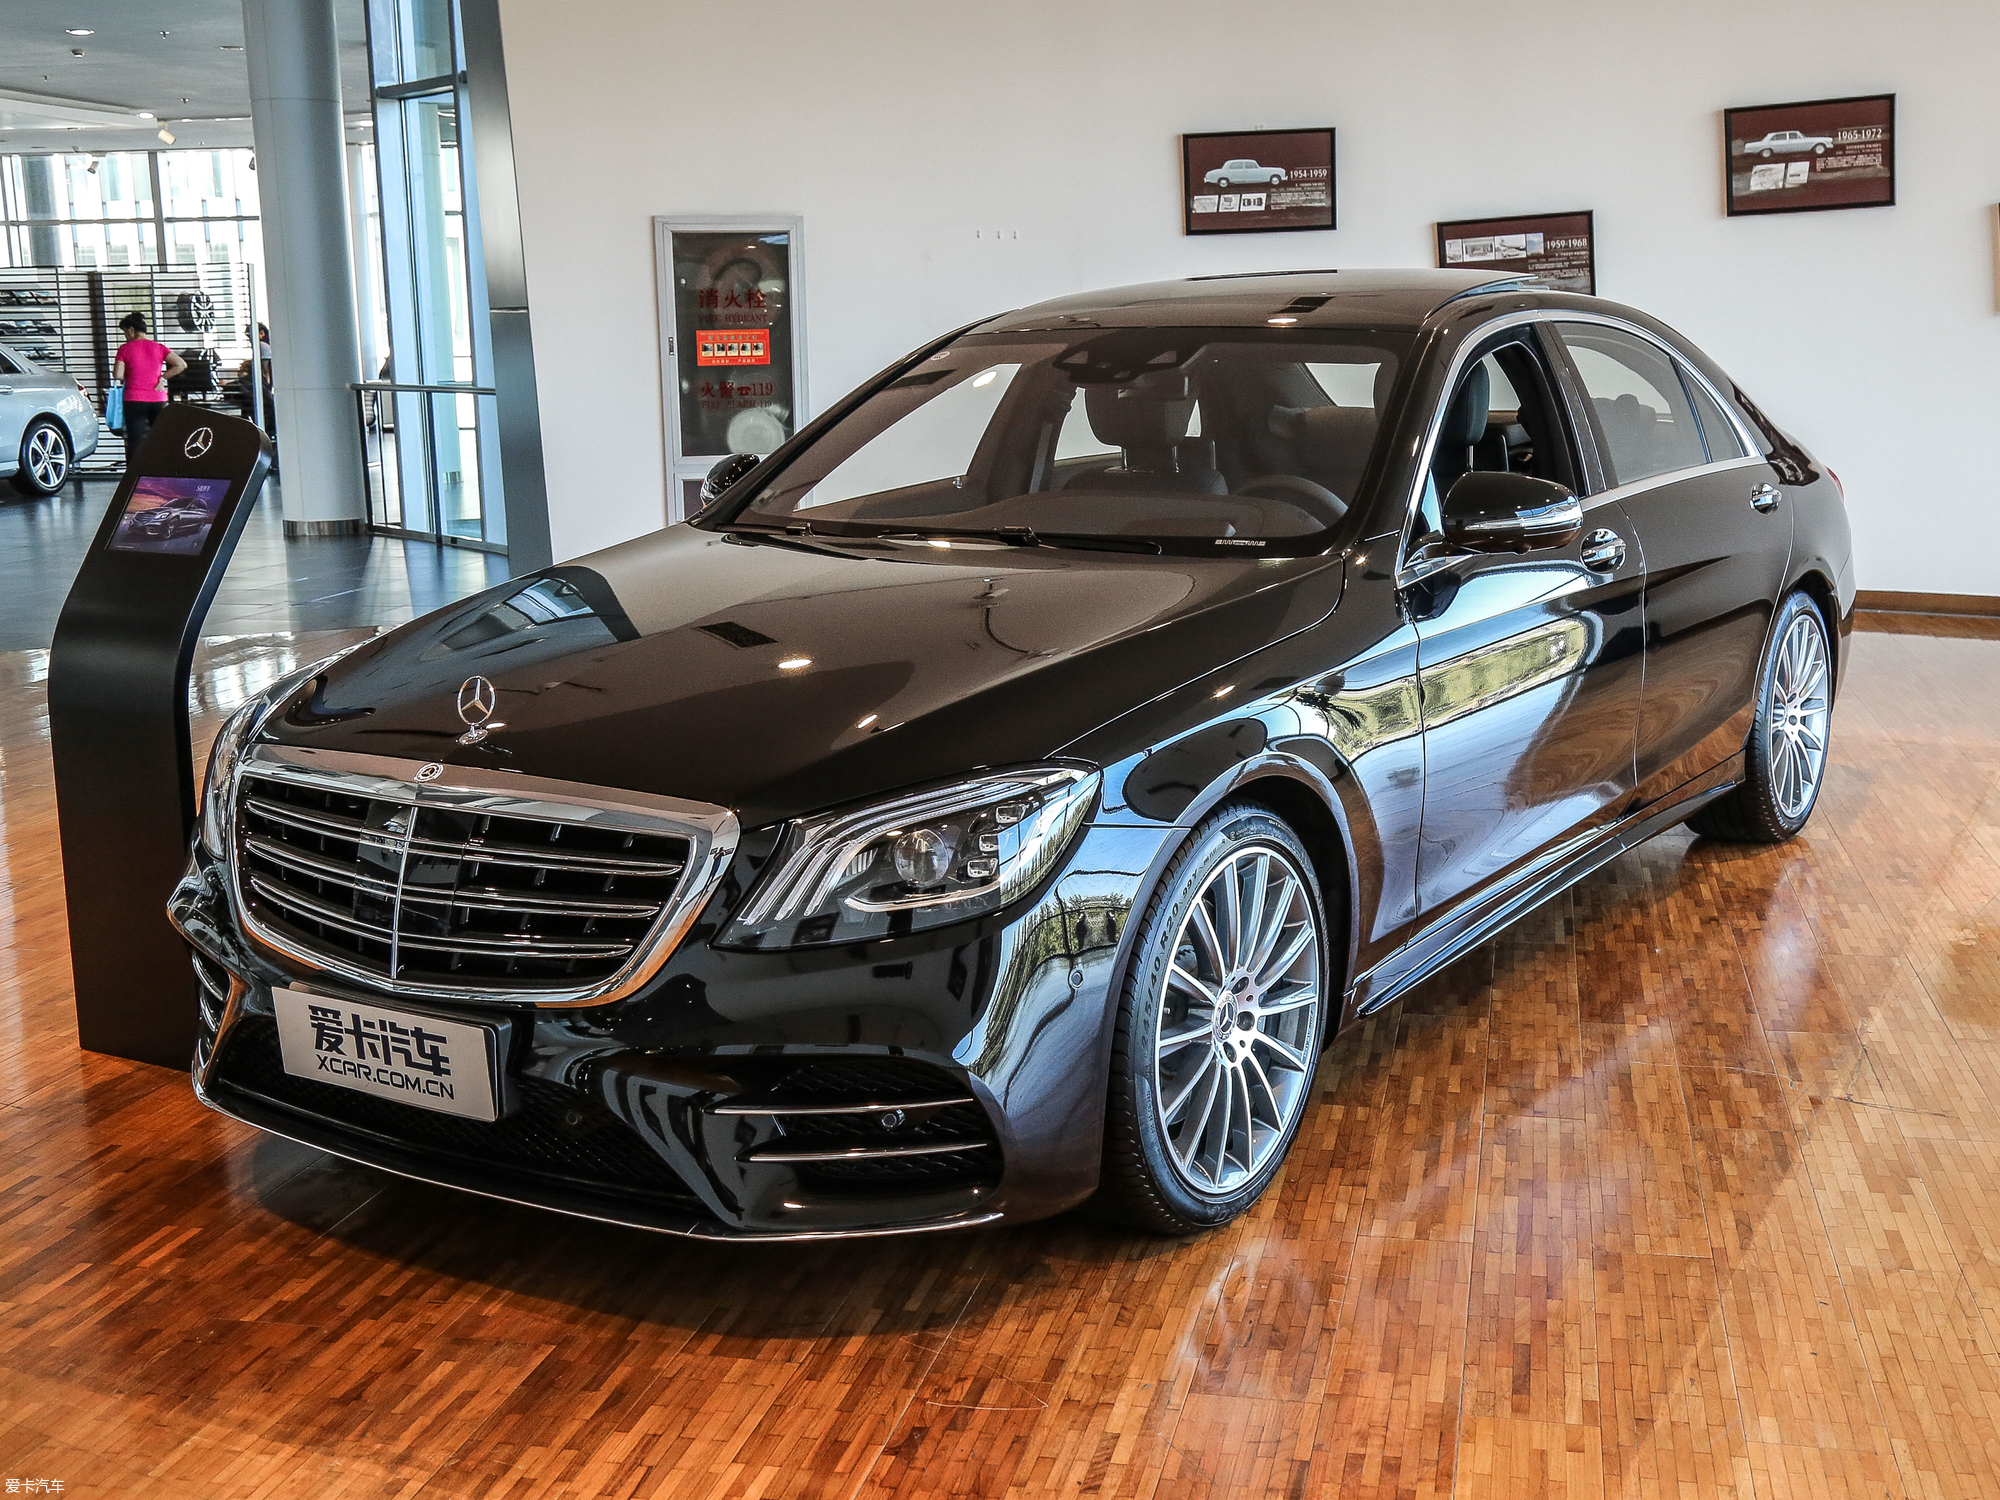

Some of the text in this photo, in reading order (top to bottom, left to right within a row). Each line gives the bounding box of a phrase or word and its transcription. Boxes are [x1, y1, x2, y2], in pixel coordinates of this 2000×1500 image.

[1837, 128, 1883, 142] 1965-1972
[1290, 168, 1328, 179] 1954-1959
[1546, 237, 1588, 250] 1959-1968
[698, 288, 767, 309] 消火栓
[725, 313, 768, 323] HYDRANT
[752, 382, 774, 396] 119
[1159, 902, 1179, 950] R20
[1182, 868, 1198, 897] 99Y
[307, 1004, 452, 1078] 爱卡汽车
[315, 1054, 455, 1101] XCAR.COM.CN
